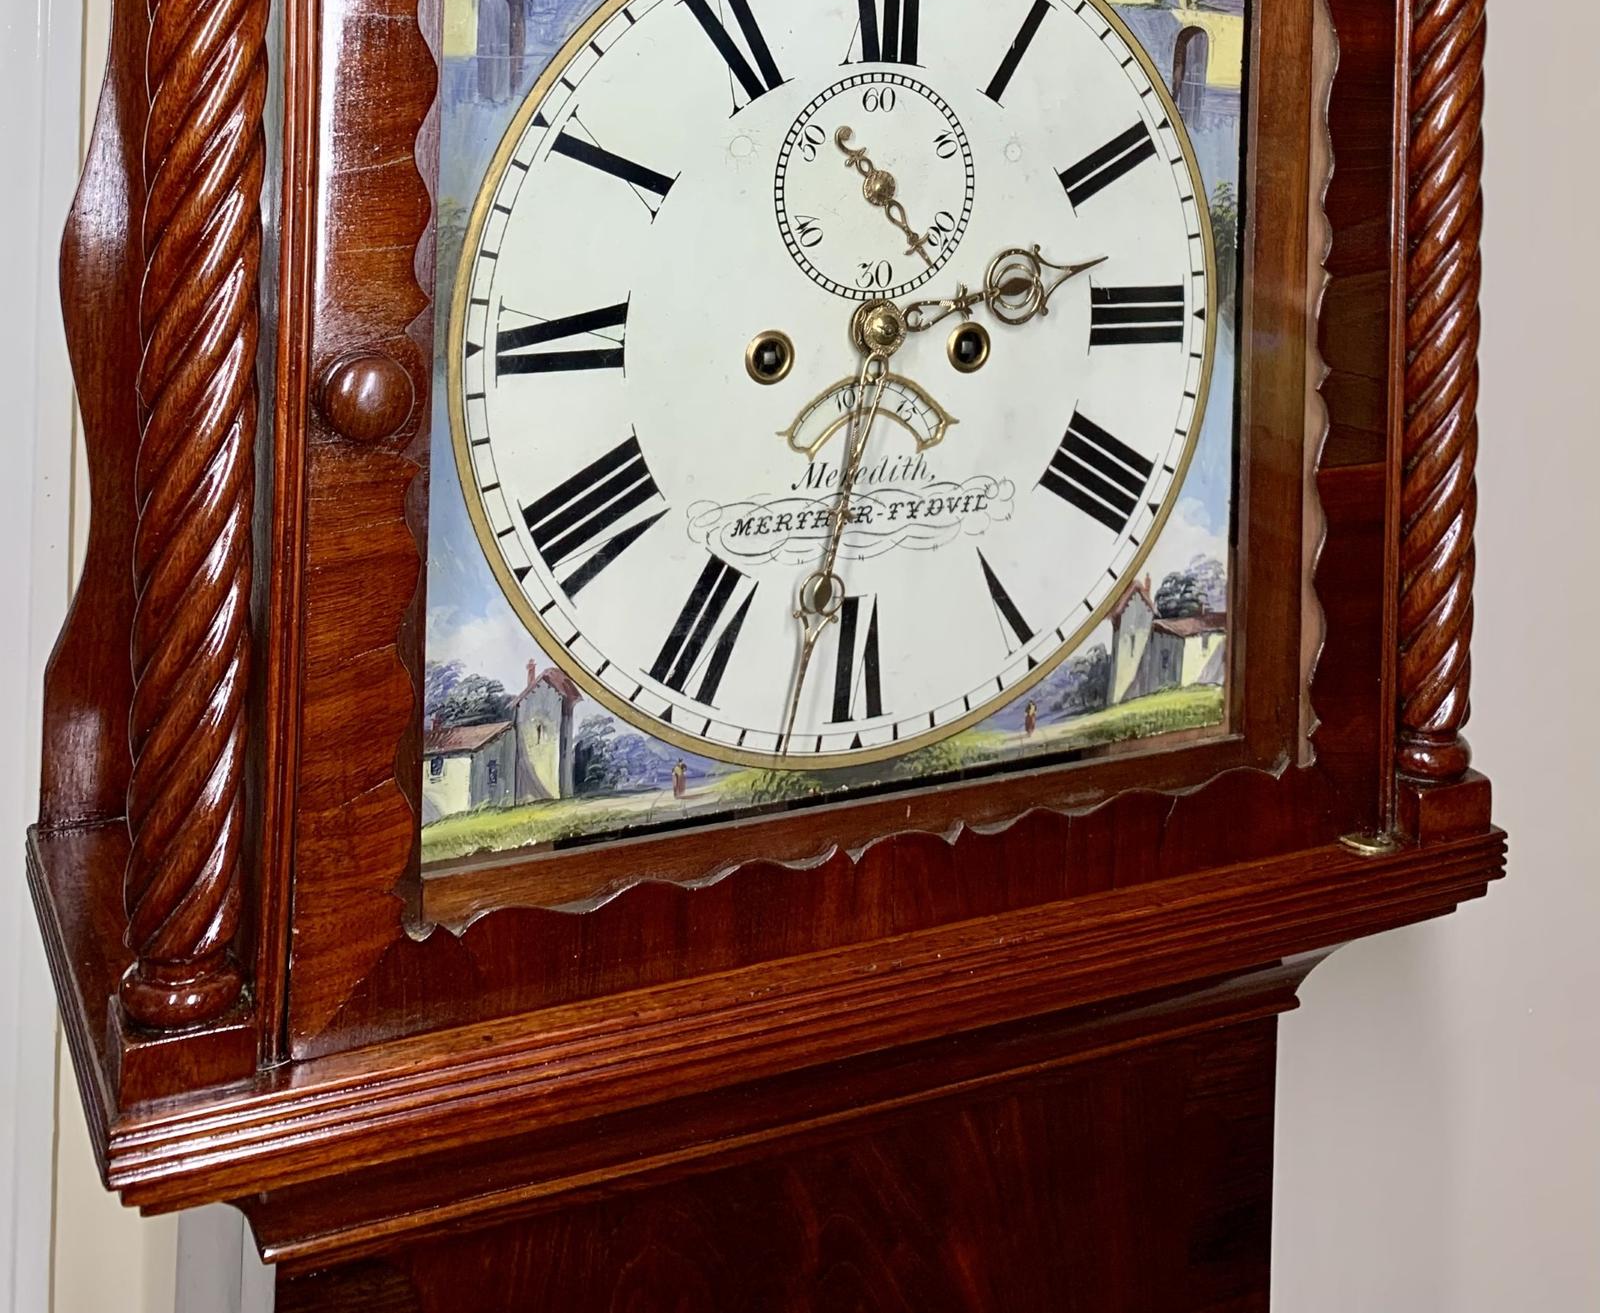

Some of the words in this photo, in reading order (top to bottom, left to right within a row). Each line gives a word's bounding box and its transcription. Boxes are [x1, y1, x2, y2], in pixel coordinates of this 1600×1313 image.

[862, 87, 896, 112] 60
[797, 124, 825, 162] 50
[932, 129, 958, 159] 10
[1053, 112, 1159, 216] II
[794, 214, 823, 247] 40
[926, 211, 955, 252] 20
[855, 260, 893, 288] 30
[1089, 275, 1184, 353] III
[834, 388, 856, 413] 10
[895, 399, 918, 423] 15
[1035, 401, 1157, 541] IIII
